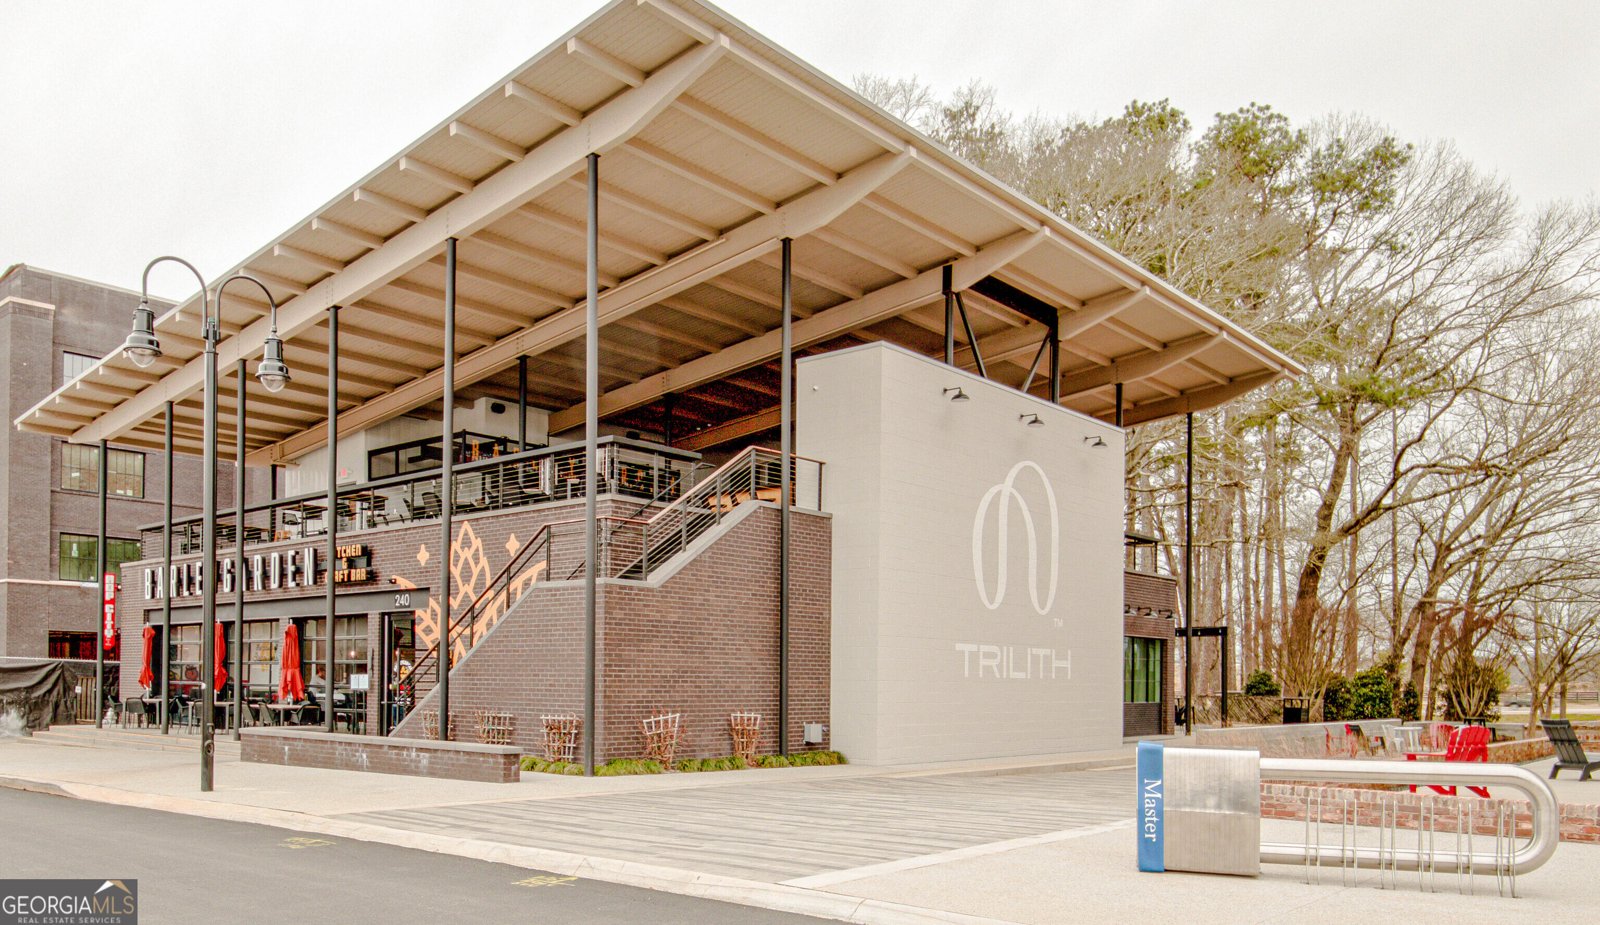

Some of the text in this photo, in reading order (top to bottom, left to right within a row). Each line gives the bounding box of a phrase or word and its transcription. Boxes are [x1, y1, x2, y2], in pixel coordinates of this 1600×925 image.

[336, 544, 361, 558] TCHEN
[324, 568, 366, 583] AFT BAR
[395, 594, 410, 606] 240
[1053, 618, 1063, 627] TM
[955, 643, 1071, 679] TRILITH
[1144, 779, 1162, 842] Master
